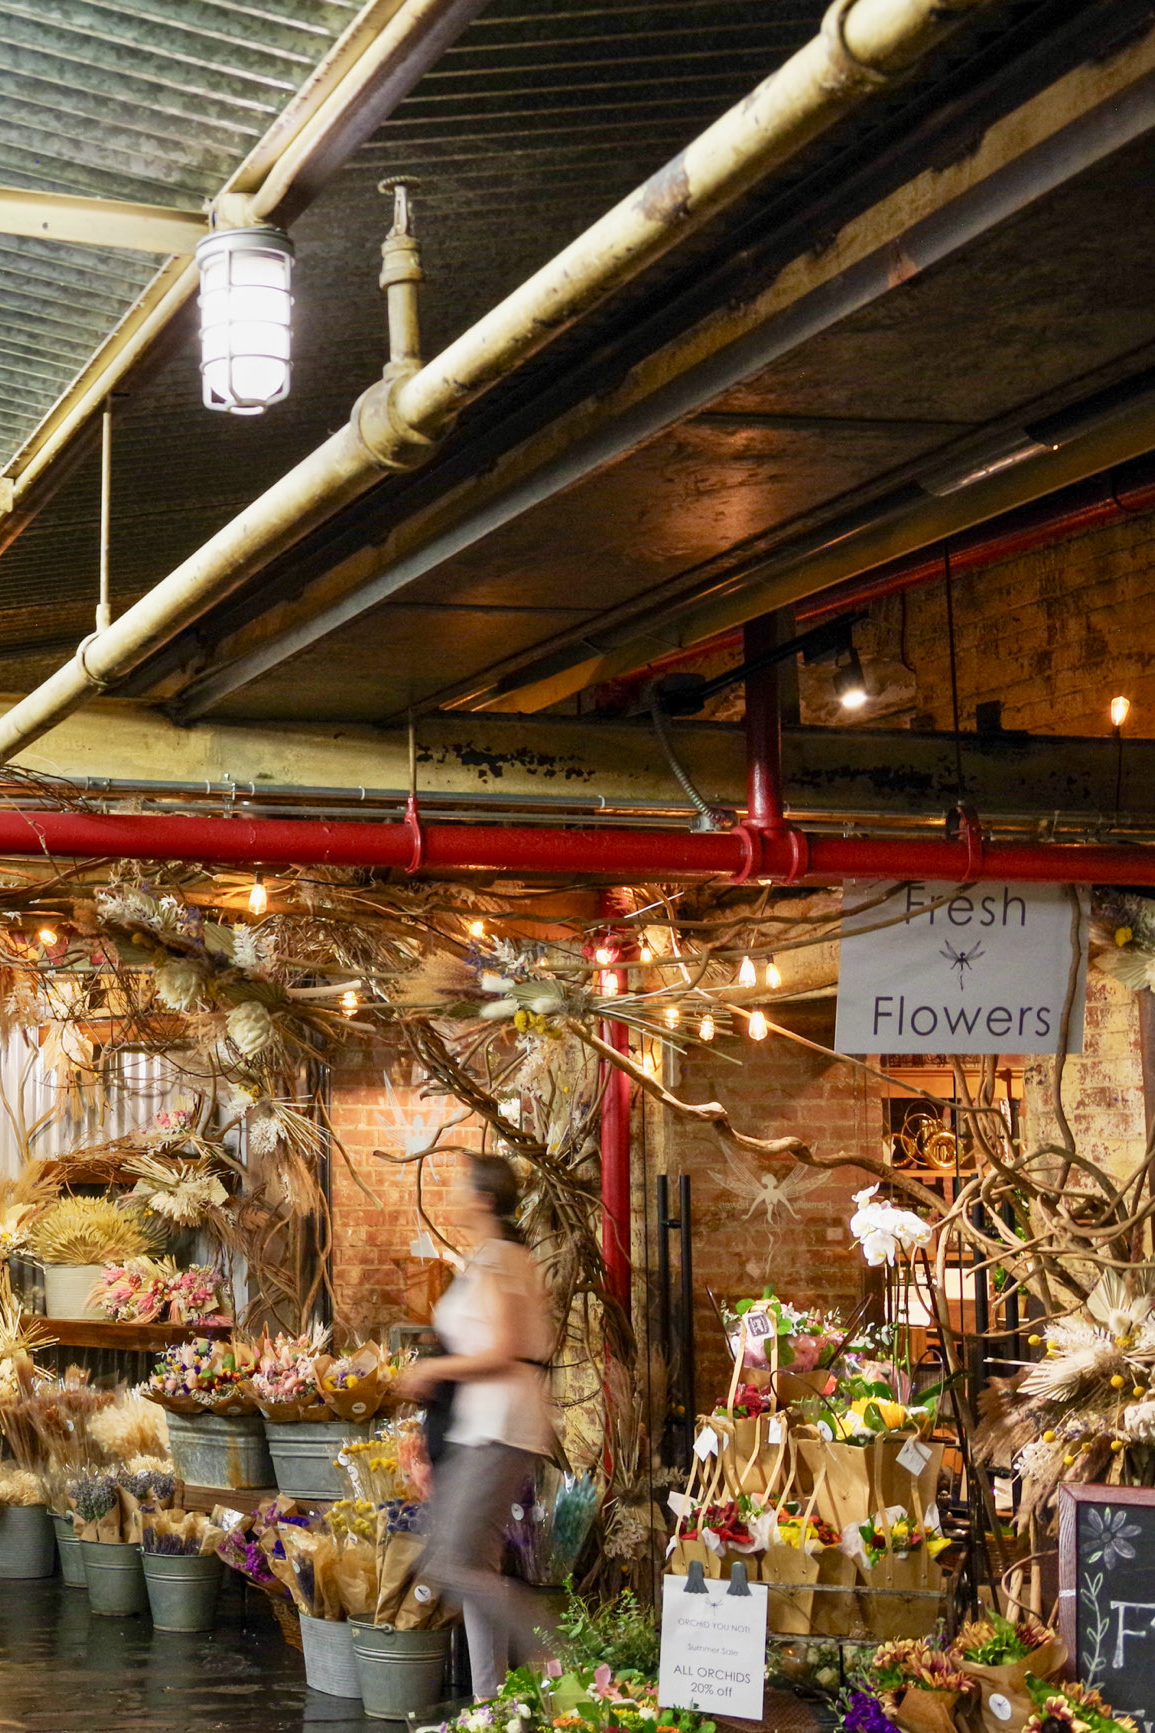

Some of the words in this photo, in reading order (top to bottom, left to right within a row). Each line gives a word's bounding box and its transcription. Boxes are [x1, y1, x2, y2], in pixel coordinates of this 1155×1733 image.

[905, 885, 1026, 927] Fresh
[872, 995, 1051, 1037] Flowers
[677, 1617, 710, 1629] ORCHID
[712, 1621, 729, 1631] YOU
[687, 1643, 719, 1655] Summer
[721, 1646, 739, 1657] Sale
[673, 1664, 694, 1676] ALL
[697, 1666, 751, 1684] ORCHIDS
[690, 1682, 714, 1695] 20%
[717, 1686, 733, 1697] off
